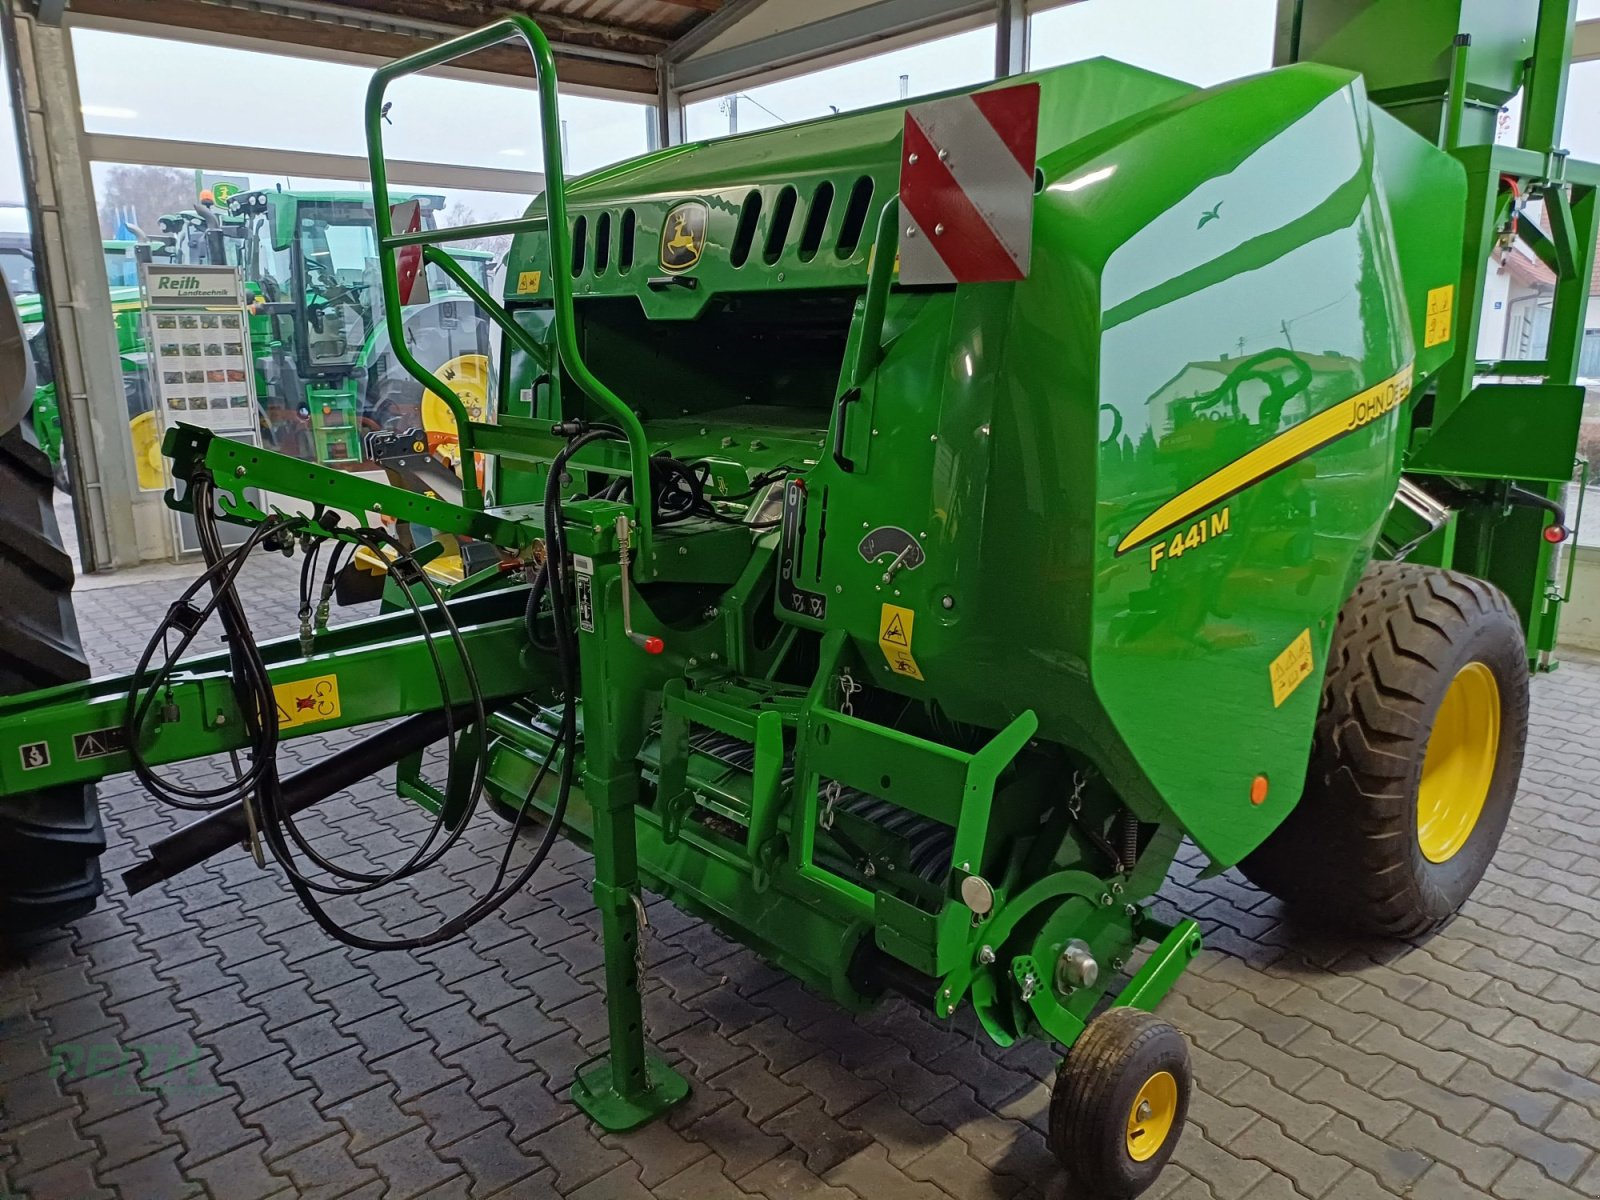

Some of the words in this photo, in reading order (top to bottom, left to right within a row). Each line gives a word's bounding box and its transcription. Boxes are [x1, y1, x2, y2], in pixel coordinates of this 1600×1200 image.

[158, 276, 200, 290] Reith
[1348, 393, 1385, 427] JOHN
[1150, 541, 1166, 571] F
[1168, 519, 1207, 558] 441
[1211, 507, 1230, 537] M
